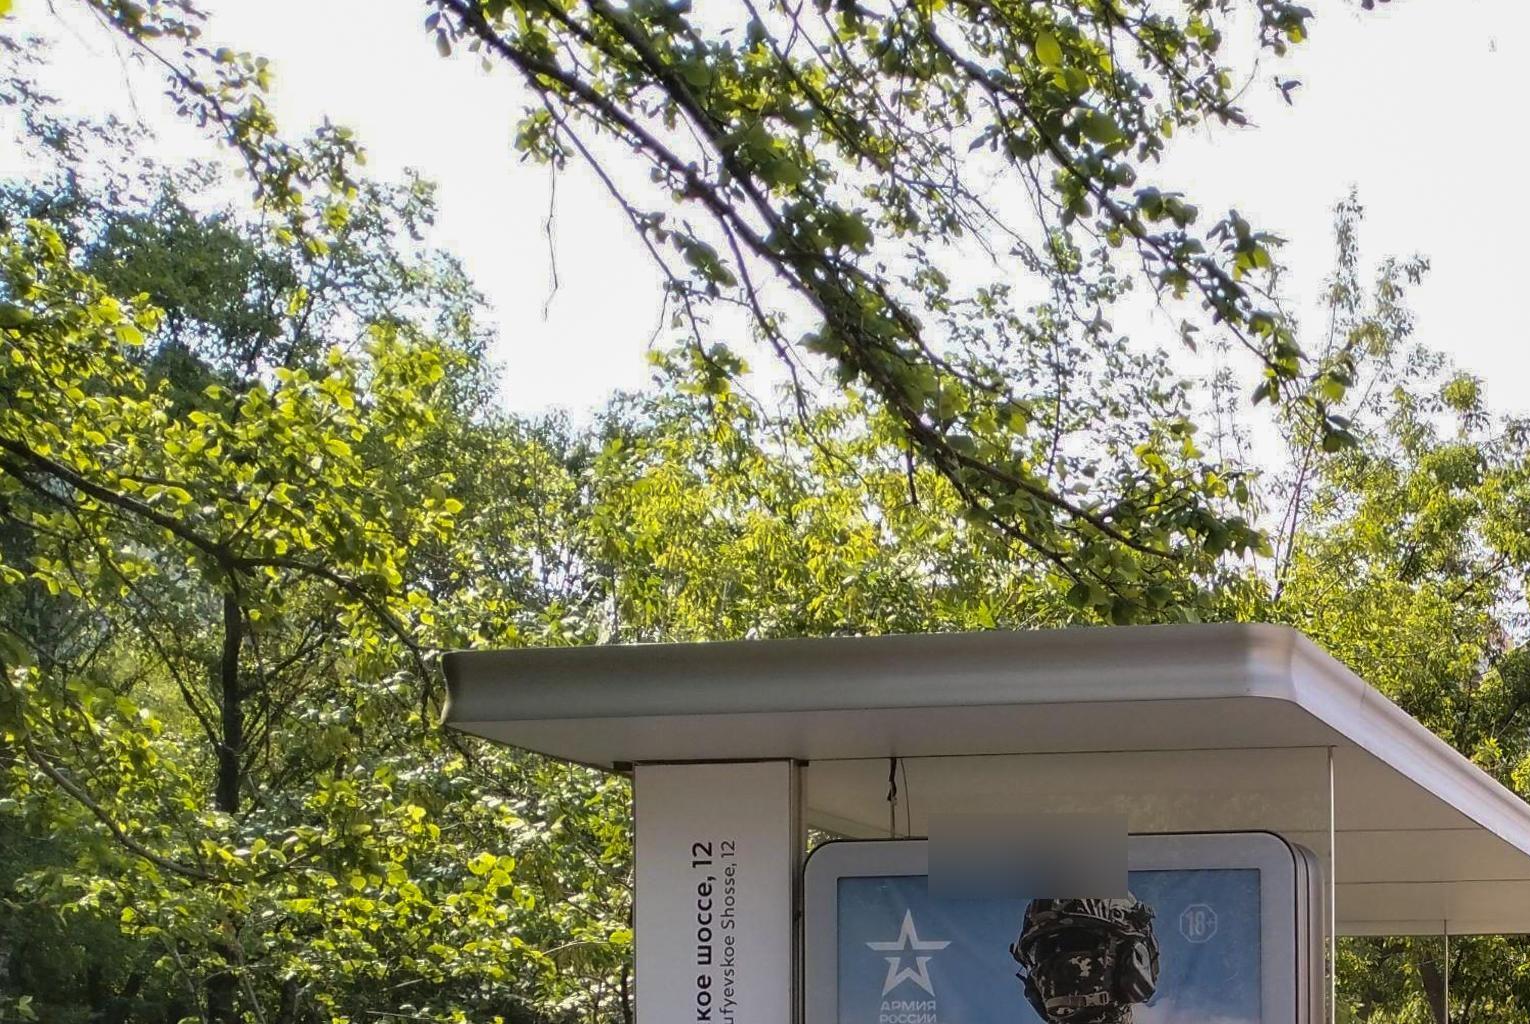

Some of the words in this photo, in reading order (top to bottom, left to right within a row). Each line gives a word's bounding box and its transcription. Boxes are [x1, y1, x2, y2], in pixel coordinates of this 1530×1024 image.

[692, 841, 712, 869] 12
[720, 840, 735, 859] 12
[720, 862, 736, 928] Shosse,
[697, 876, 716, 965] шоссе,
[1185, 911, 1215, 937] 18+
[880, 1000, 936, 1011] АРМИЯ
[880, 1014, 936, 1024] РОССИИ
